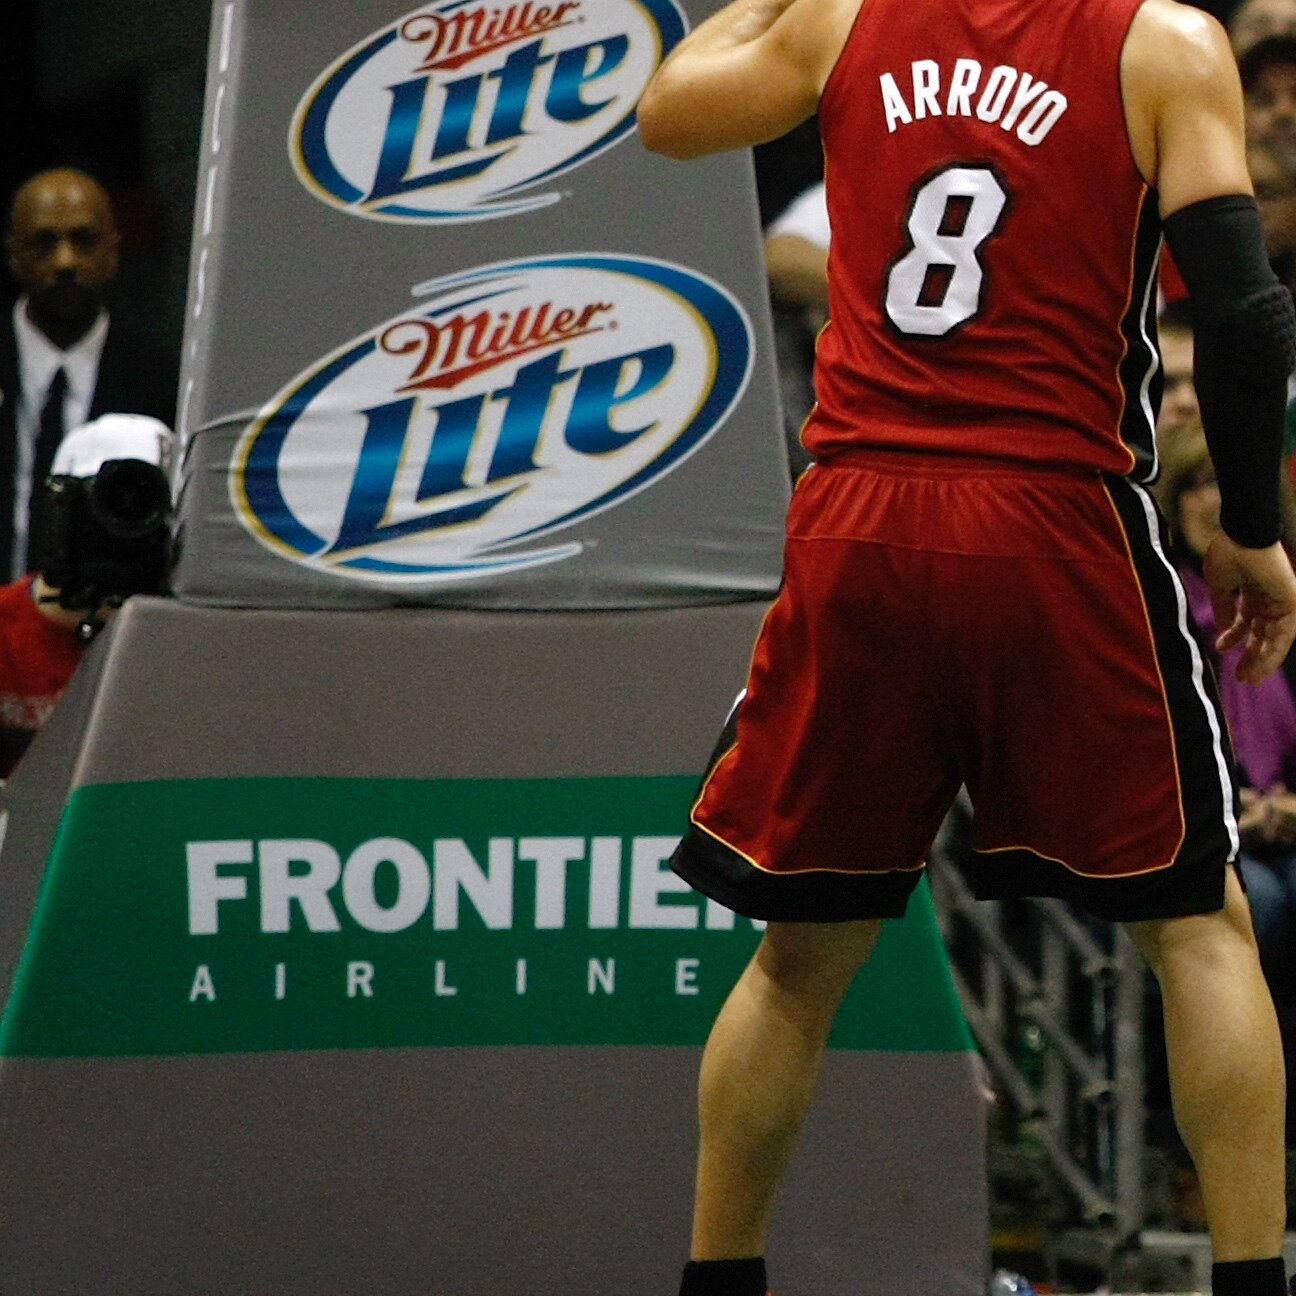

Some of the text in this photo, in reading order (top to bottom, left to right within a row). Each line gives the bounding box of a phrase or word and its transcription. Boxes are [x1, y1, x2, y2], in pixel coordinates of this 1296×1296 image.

[401, 1, 582, 68] Miller
[363, 32, 630, 203] Lite
[879, 57, 1068, 147] ARROYO
[884, 166, 1009, 337] 8
[381, 301, 613, 388] Miller
[321, 341, 675, 555] Lite
[185, 836, 768, 935] FRONTIE
[189, 957, 700, 1003] AIRLINE
